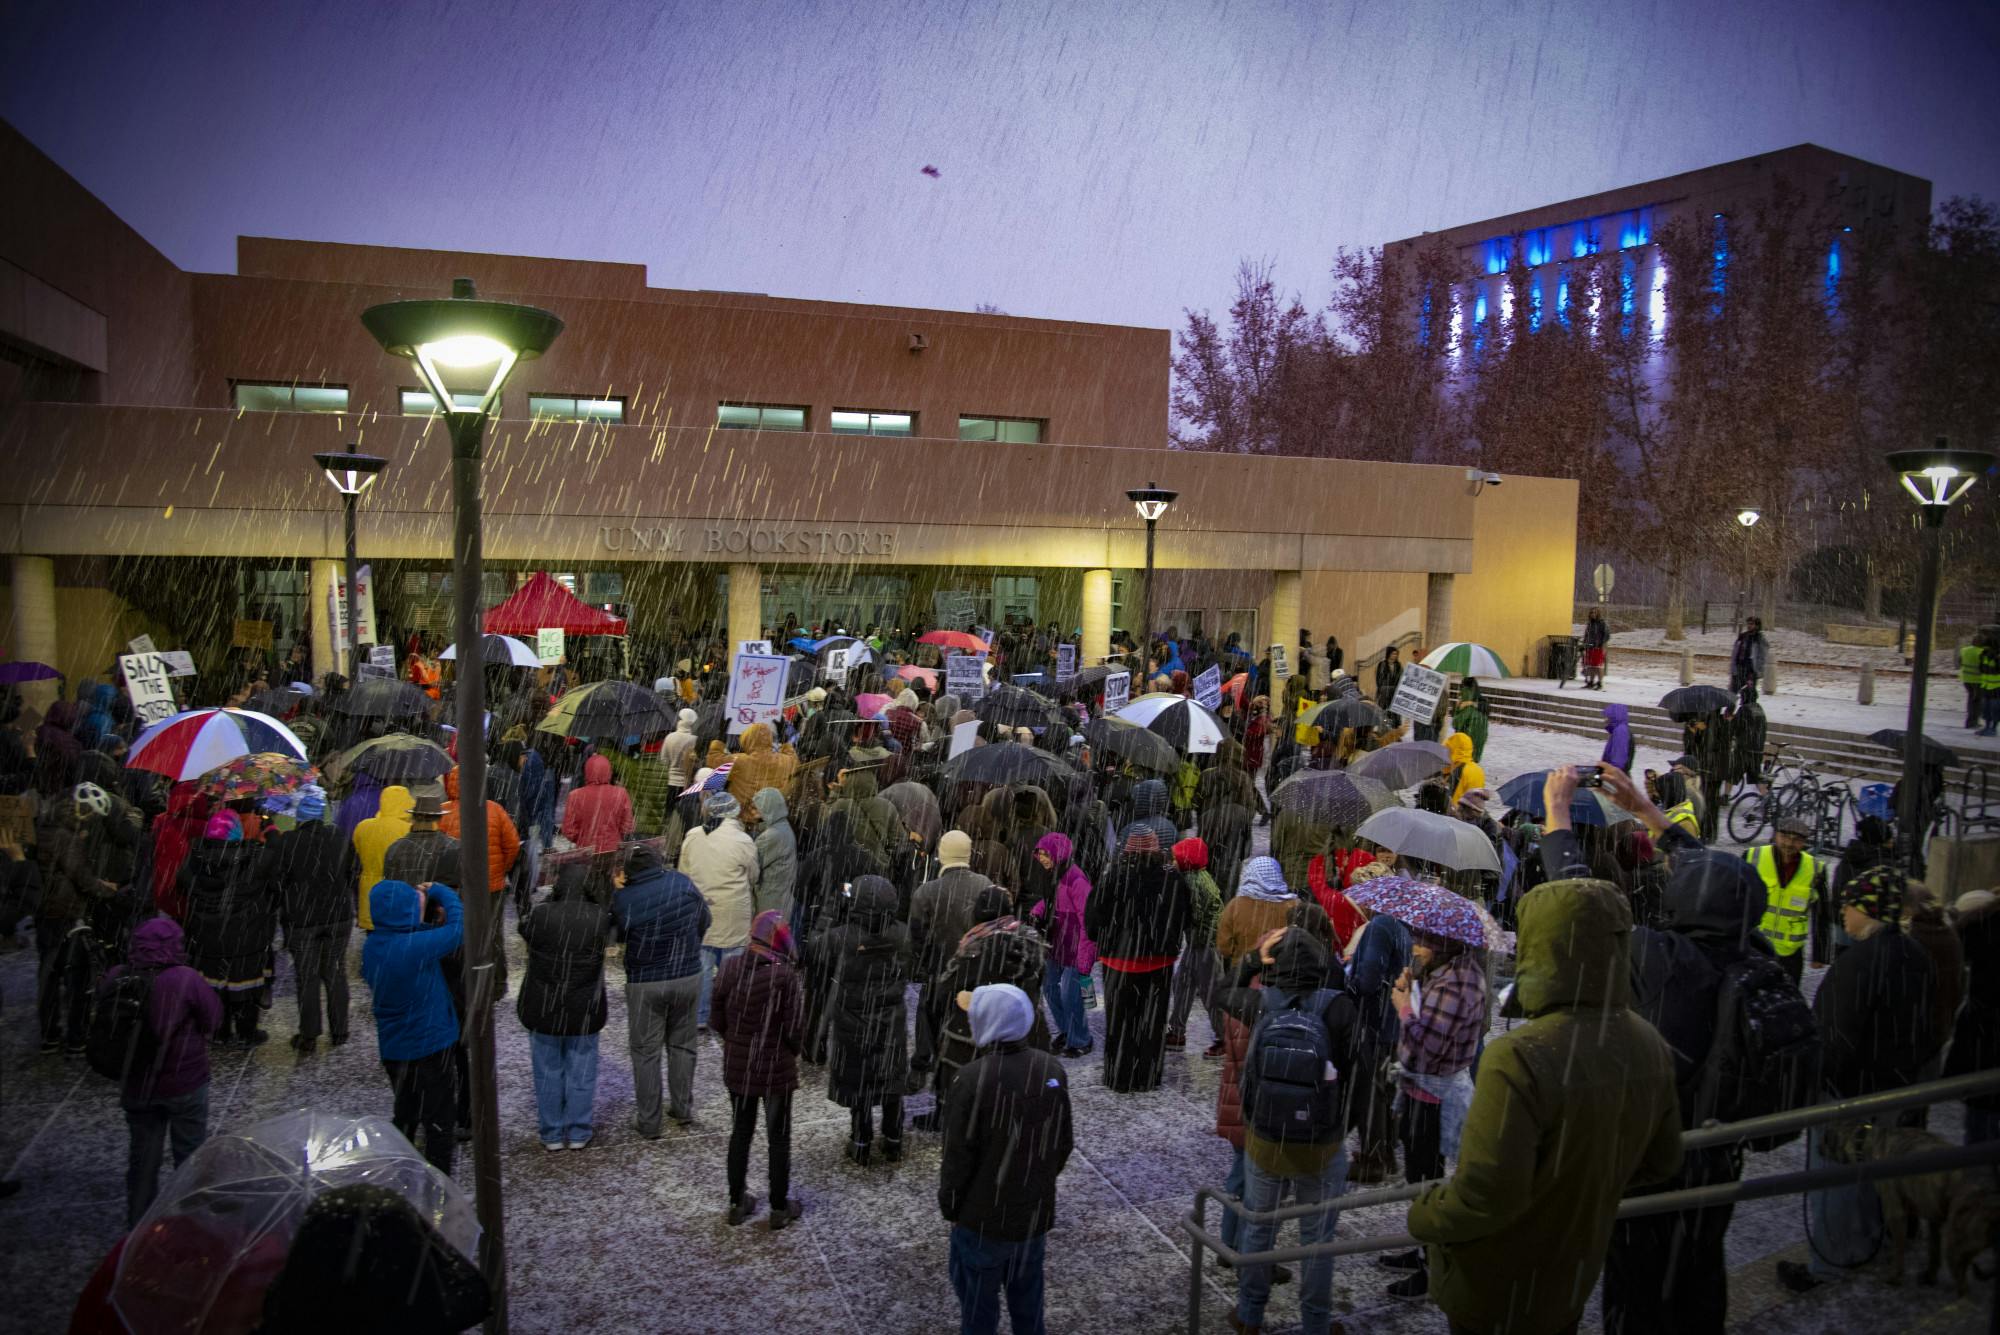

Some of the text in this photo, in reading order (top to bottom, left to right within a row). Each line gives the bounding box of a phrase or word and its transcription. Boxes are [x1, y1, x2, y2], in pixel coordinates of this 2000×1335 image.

[601, 527, 897, 556] UNM BOOKSTORE
[541, 632, 560, 643] NO
[540, 645, 561, 658] ICE
[1059, 647, 1073, 662] STOP
[1272, 645, 1284, 660] STOP
[126, 655, 161, 679] SALT
[833, 651, 845, 669] ICE
[138, 678, 165, 694] THE
[1107, 675, 1128, 698] STOP
